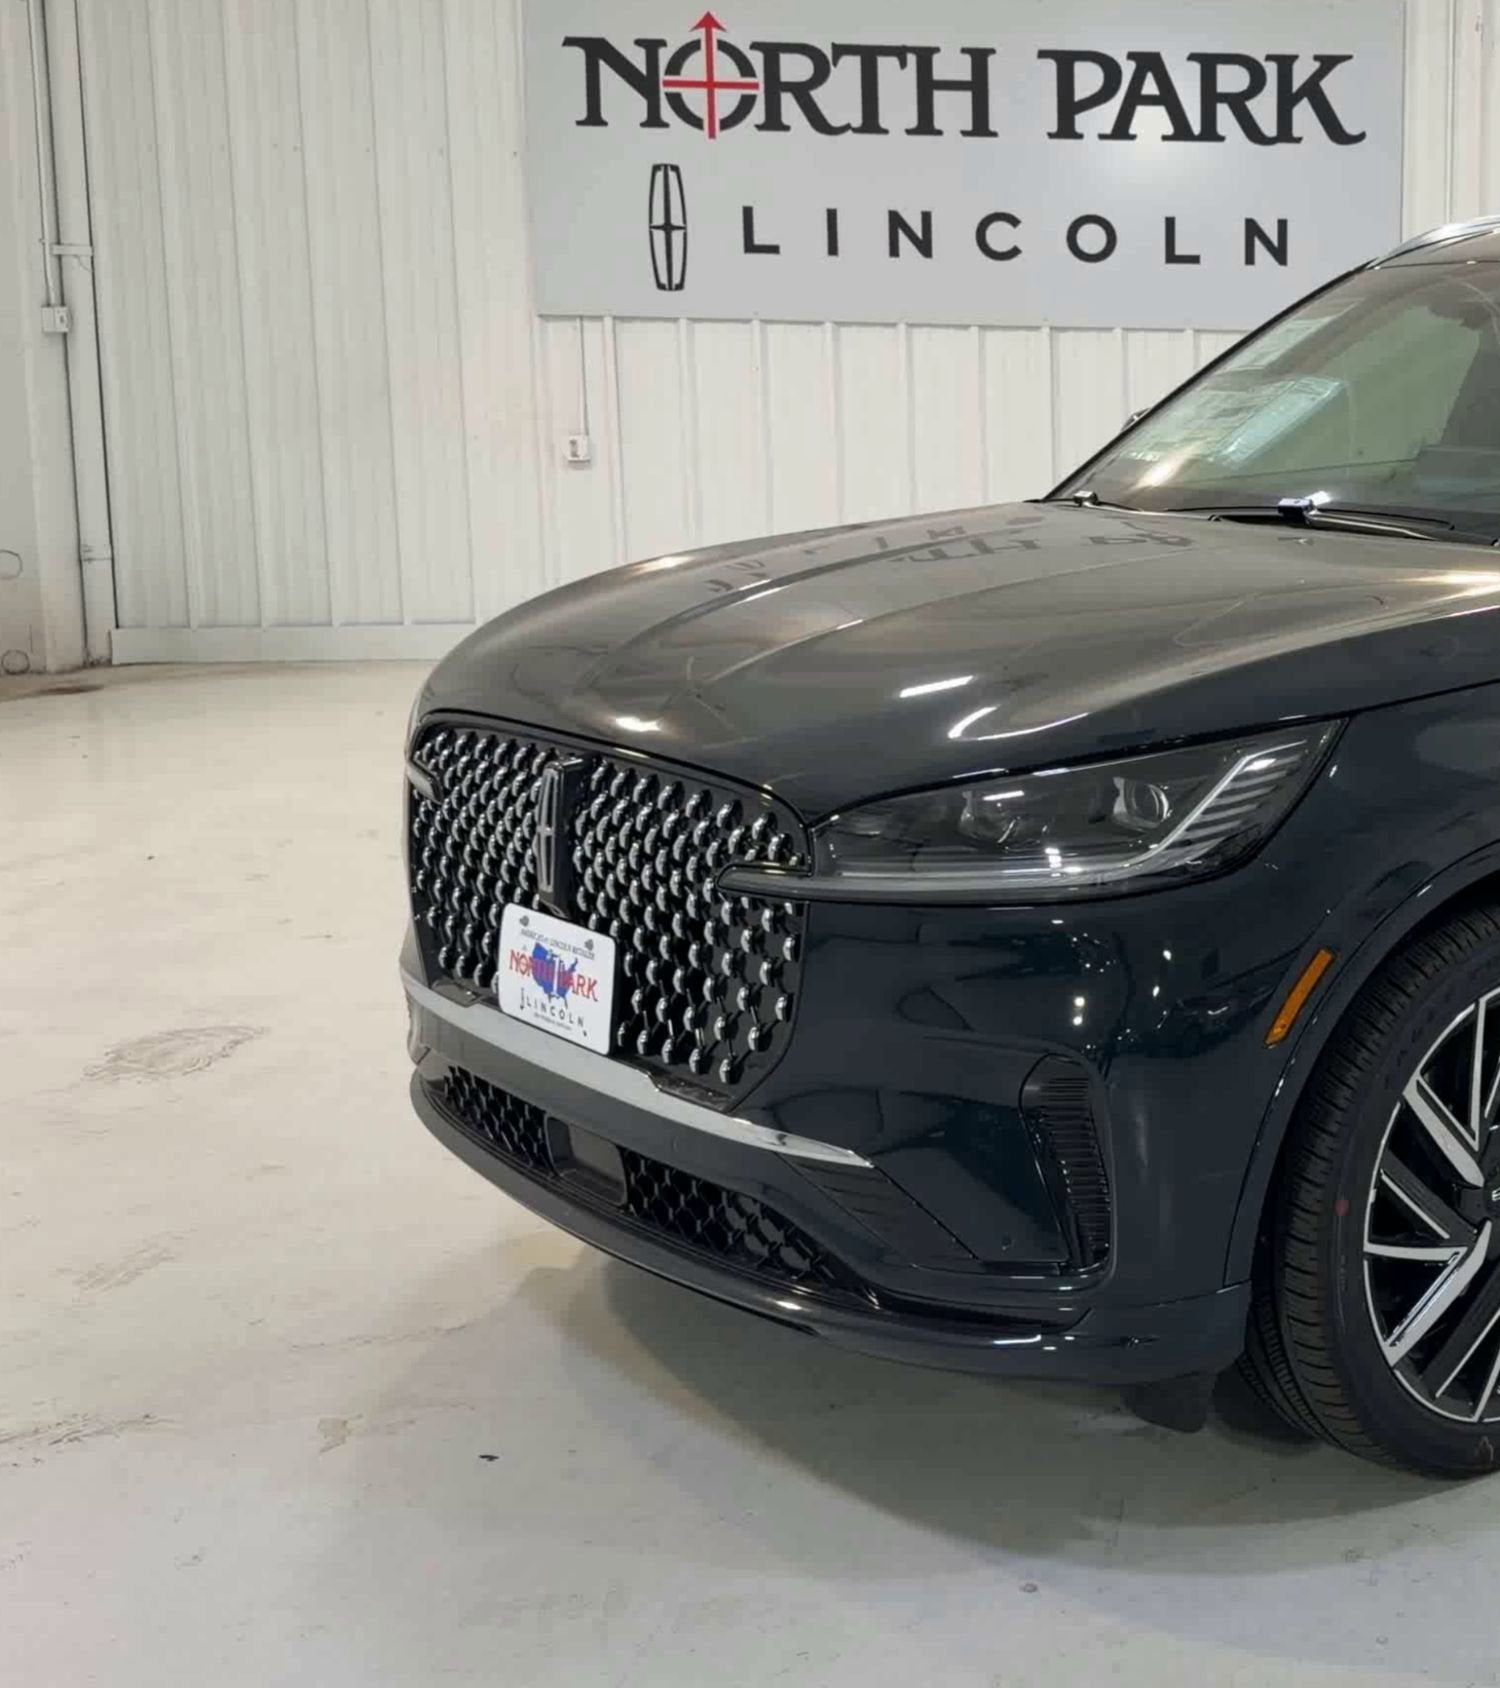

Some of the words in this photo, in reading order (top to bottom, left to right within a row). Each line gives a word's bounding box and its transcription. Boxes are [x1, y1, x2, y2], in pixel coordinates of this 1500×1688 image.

[562, 36, 998, 139] NORTH
[1036, 49, 1367, 147] PARK
[742, 205, 1288, 267] LINCOLN
[526, 995, 585, 1028] LINCOLN
